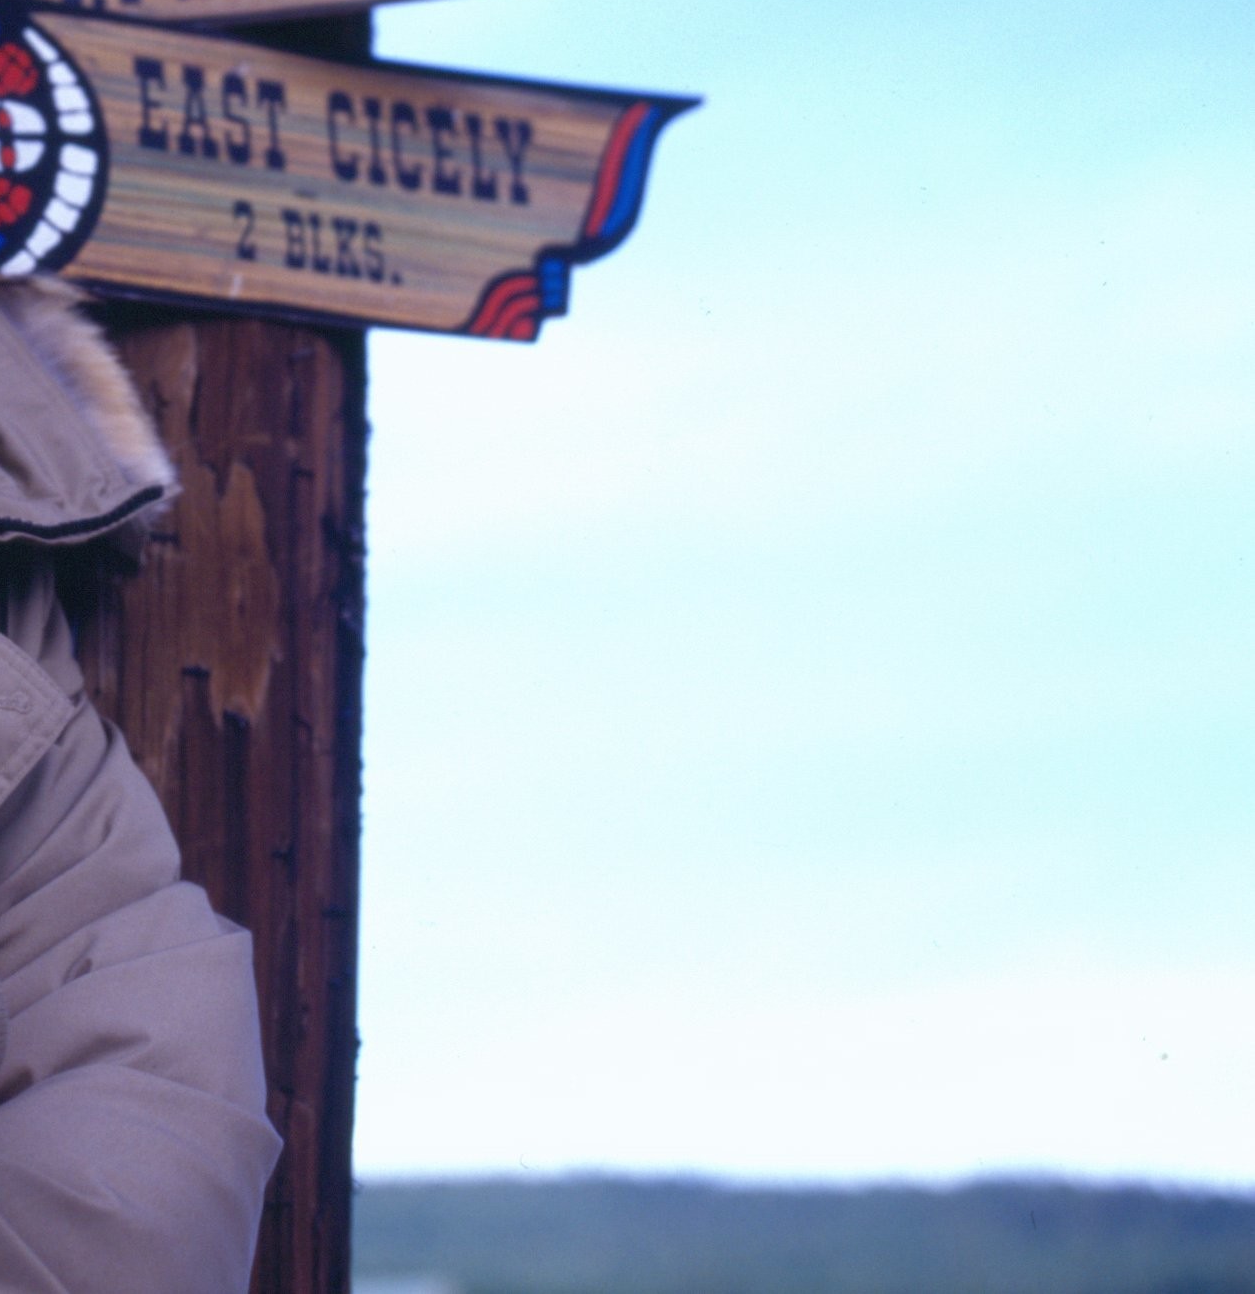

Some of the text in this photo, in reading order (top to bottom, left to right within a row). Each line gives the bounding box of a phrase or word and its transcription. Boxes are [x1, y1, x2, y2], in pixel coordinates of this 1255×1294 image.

[132, 56, 535, 206] EAST CICELY
[232, 200, 405, 287] 2 BLKS.
